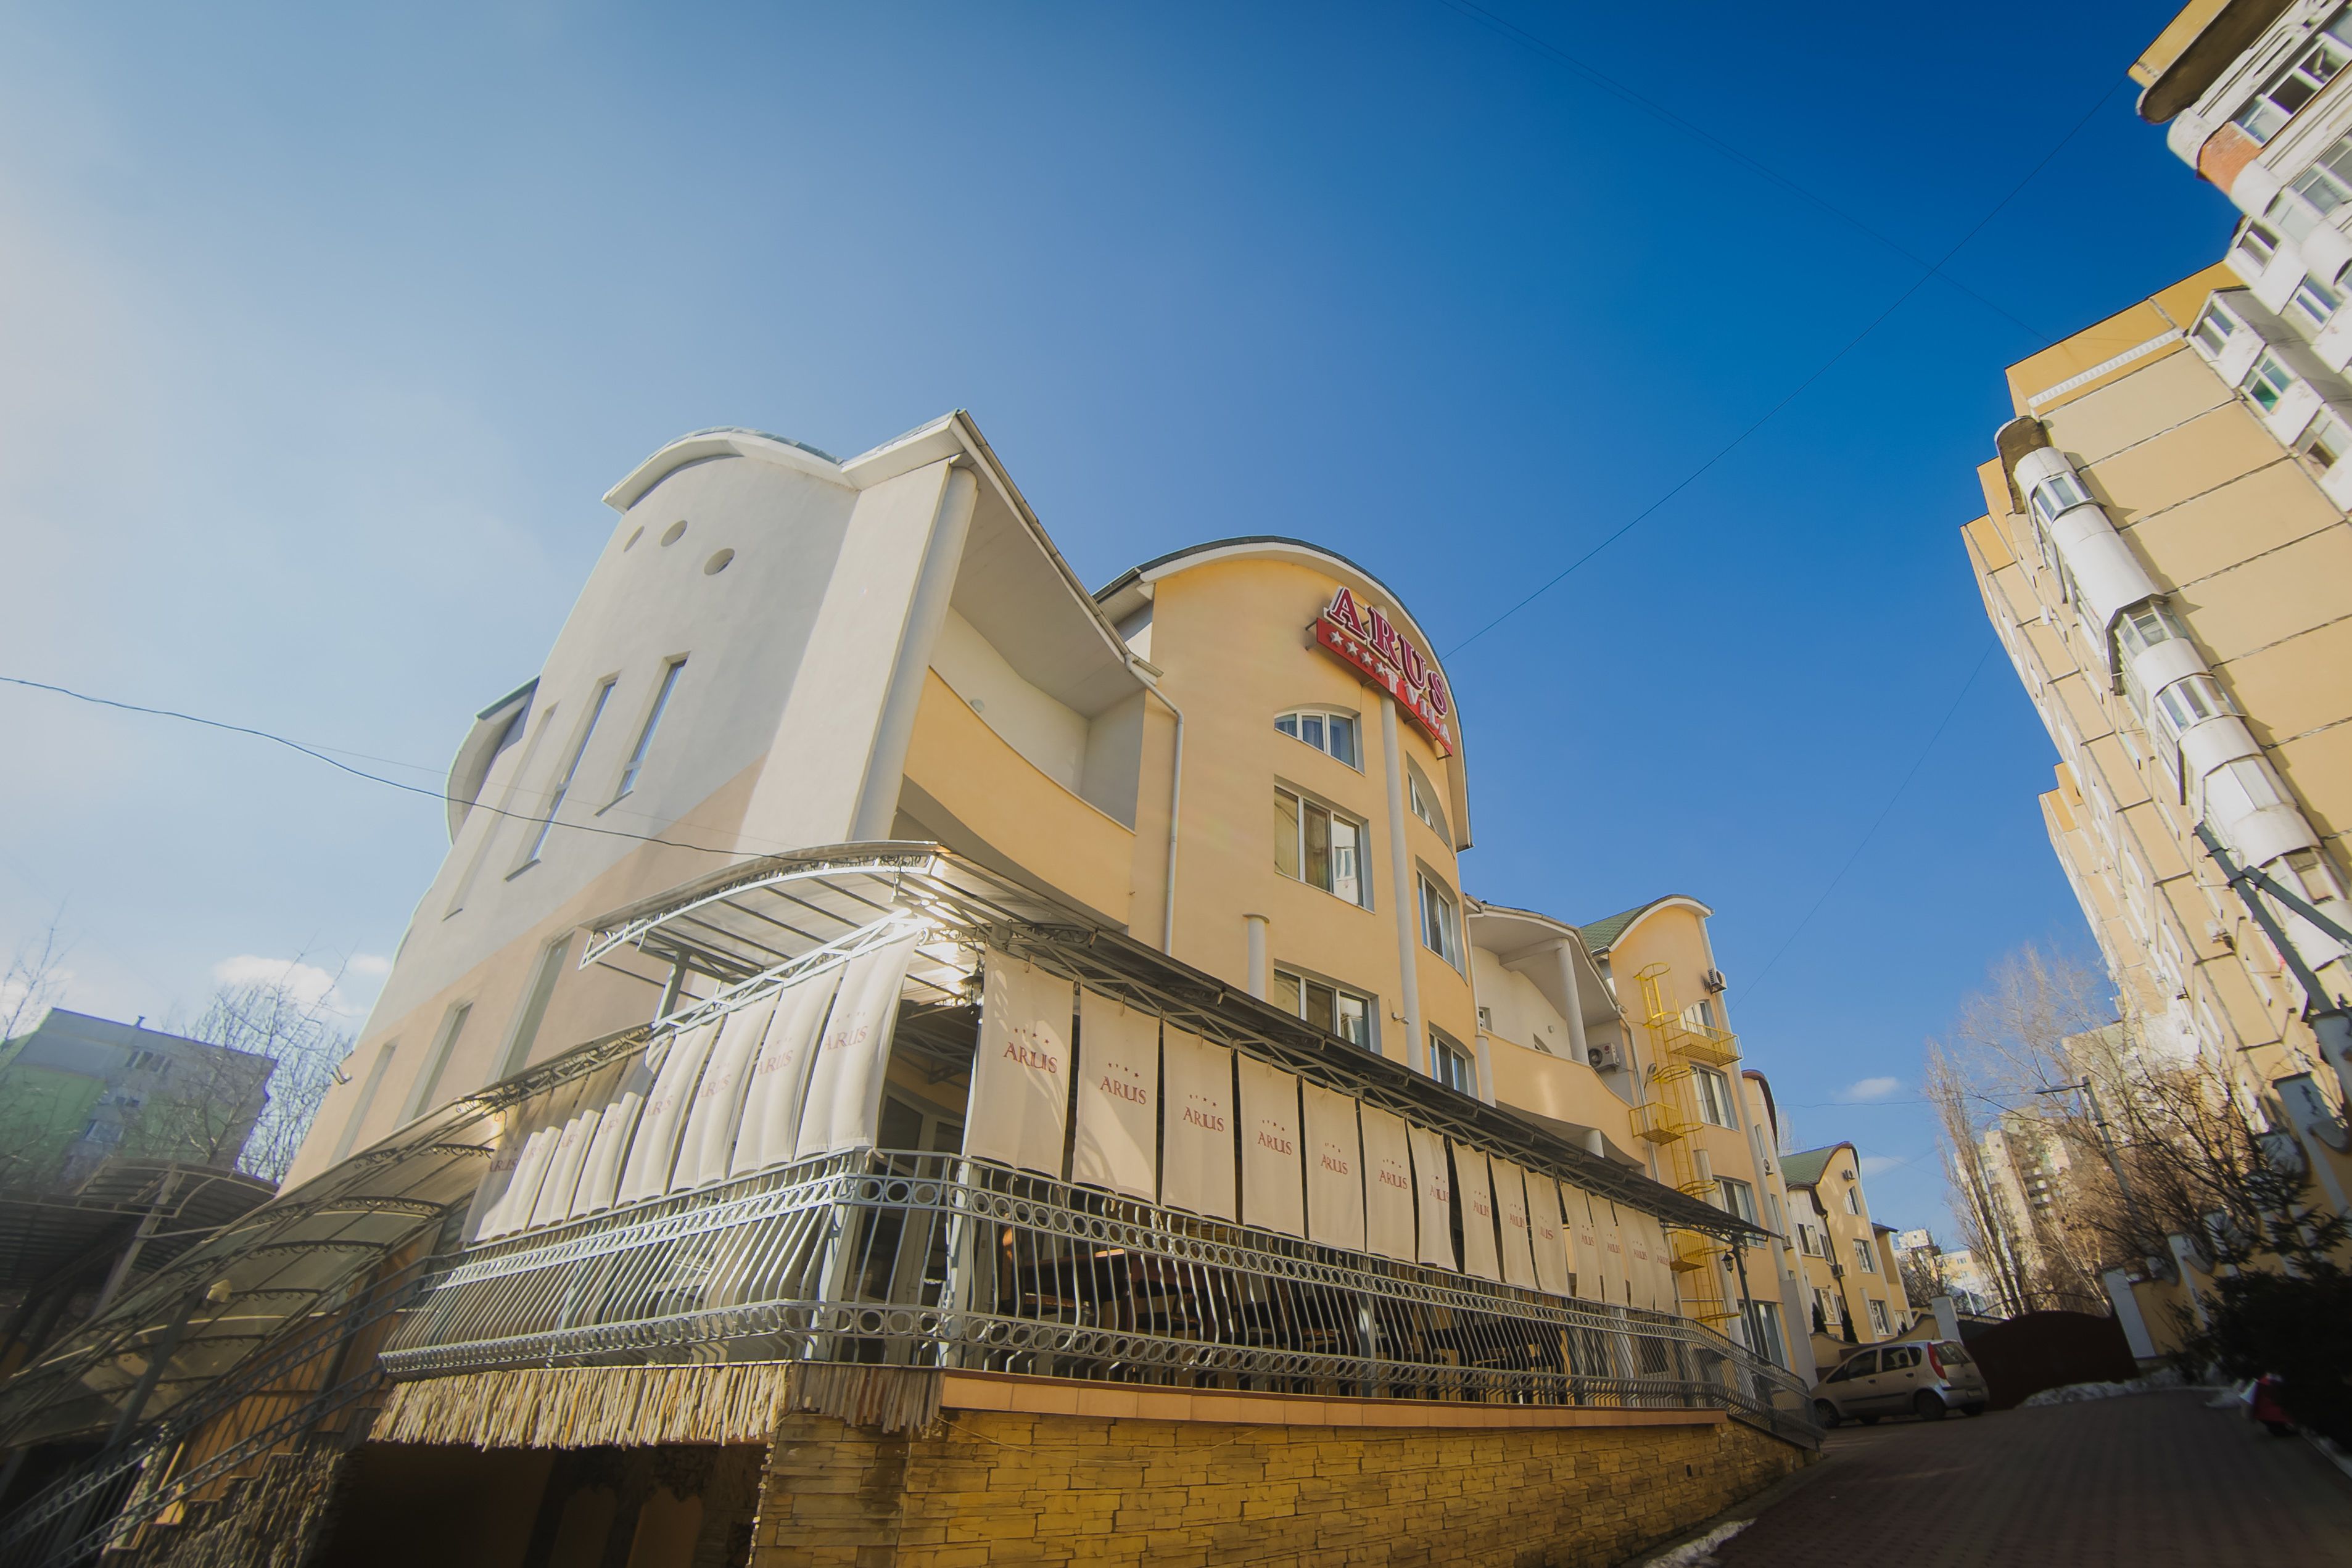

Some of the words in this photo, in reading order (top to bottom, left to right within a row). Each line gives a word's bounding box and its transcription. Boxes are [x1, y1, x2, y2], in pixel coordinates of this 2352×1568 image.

[1324, 585, 1448, 719] ARUS
[822, 1025, 868, 1050] ARUS
[1004, 1041, 1057, 1073] ARUS
[1100, 1075, 1147, 1105] ARUS
[1182, 1106, 1224, 1132] ARUS
[1258, 1131, 1292, 1155] ARUS
[1321, 1154, 1348, 1175] ARUS
[1379, 1170, 1408, 1190] ARUS
